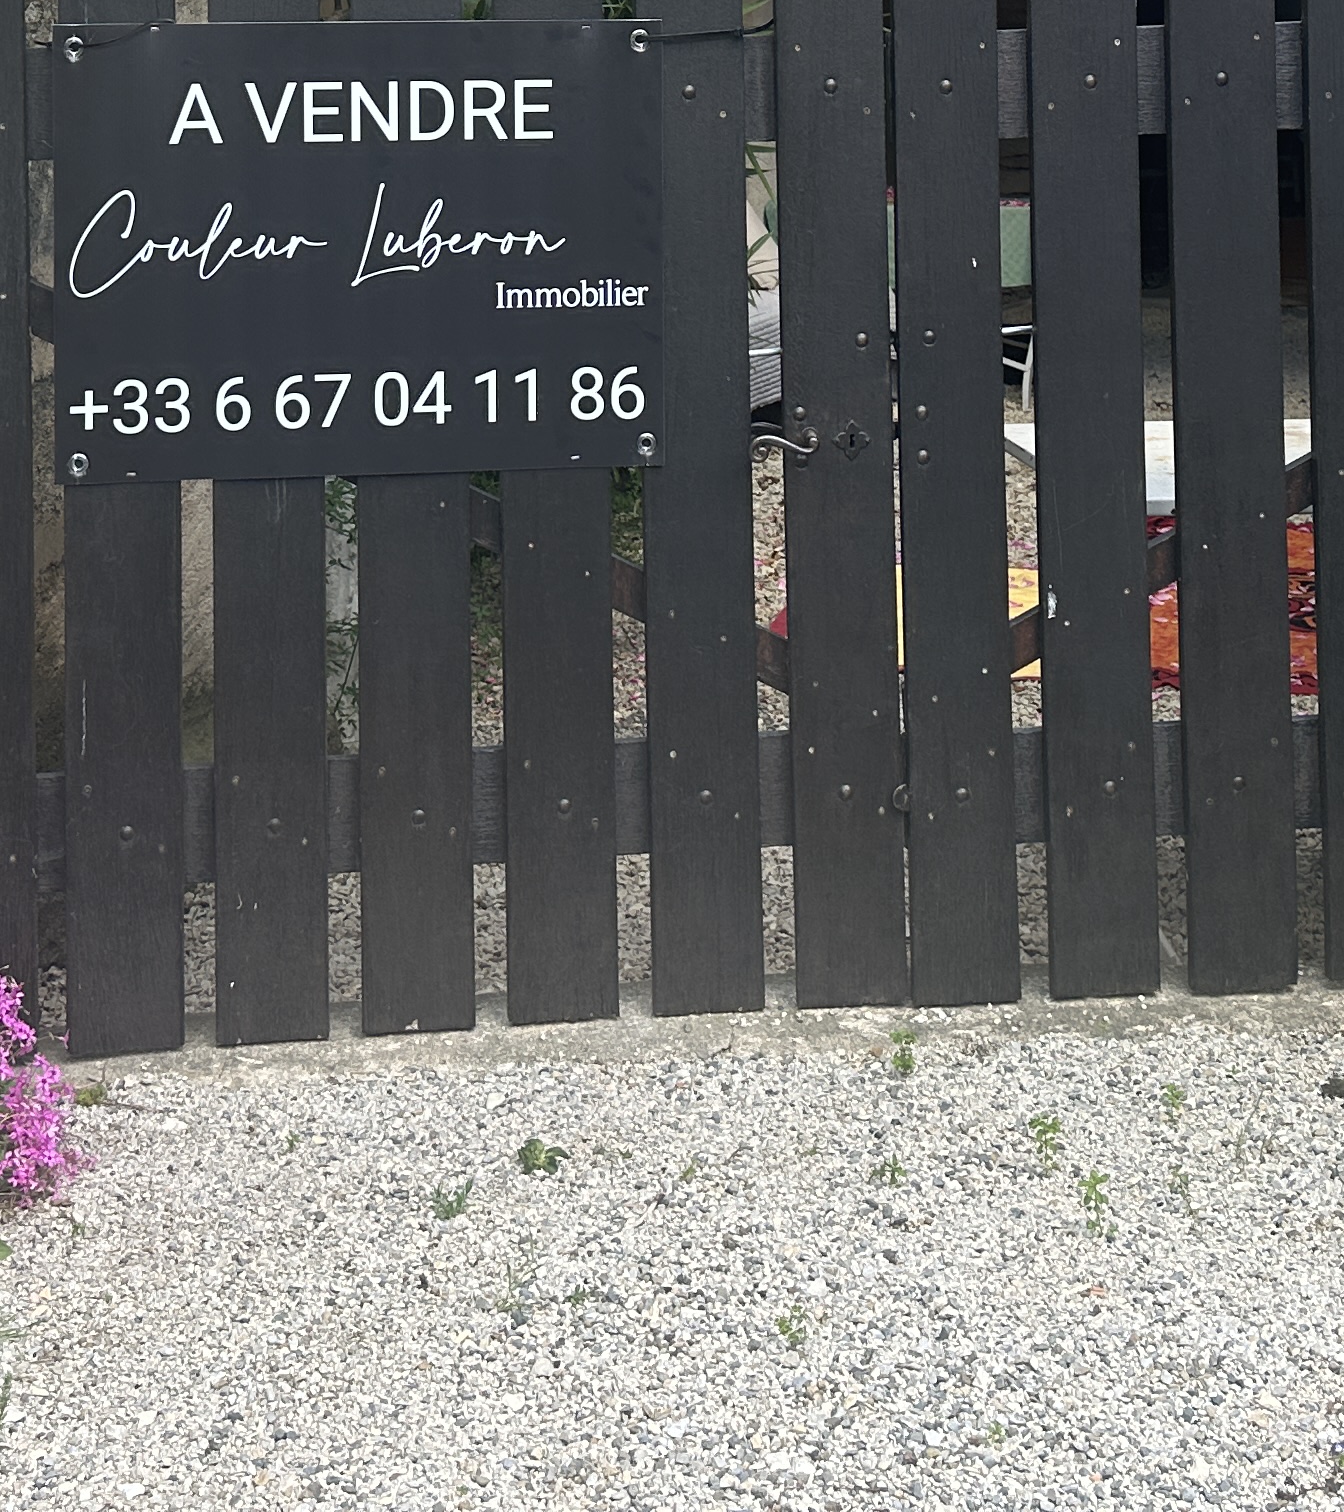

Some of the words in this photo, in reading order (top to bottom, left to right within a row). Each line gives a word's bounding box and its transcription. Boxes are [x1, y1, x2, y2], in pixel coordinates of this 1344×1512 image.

[168, 83, 224, 145] A
[244, 79, 554, 144] VENDRE
[68, 189, 328, 299] Couleur
[350, 182, 566, 287] Luberon
[495, 278, 650, 309] Immobilier
[69, 377, 191, 435] +33
[215, 376, 252, 432] 6
[275, 373, 352, 430] 67
[374, 370, 452, 427] 04
[474, 368, 539, 423] 11
[570, 365, 645, 421] 86
